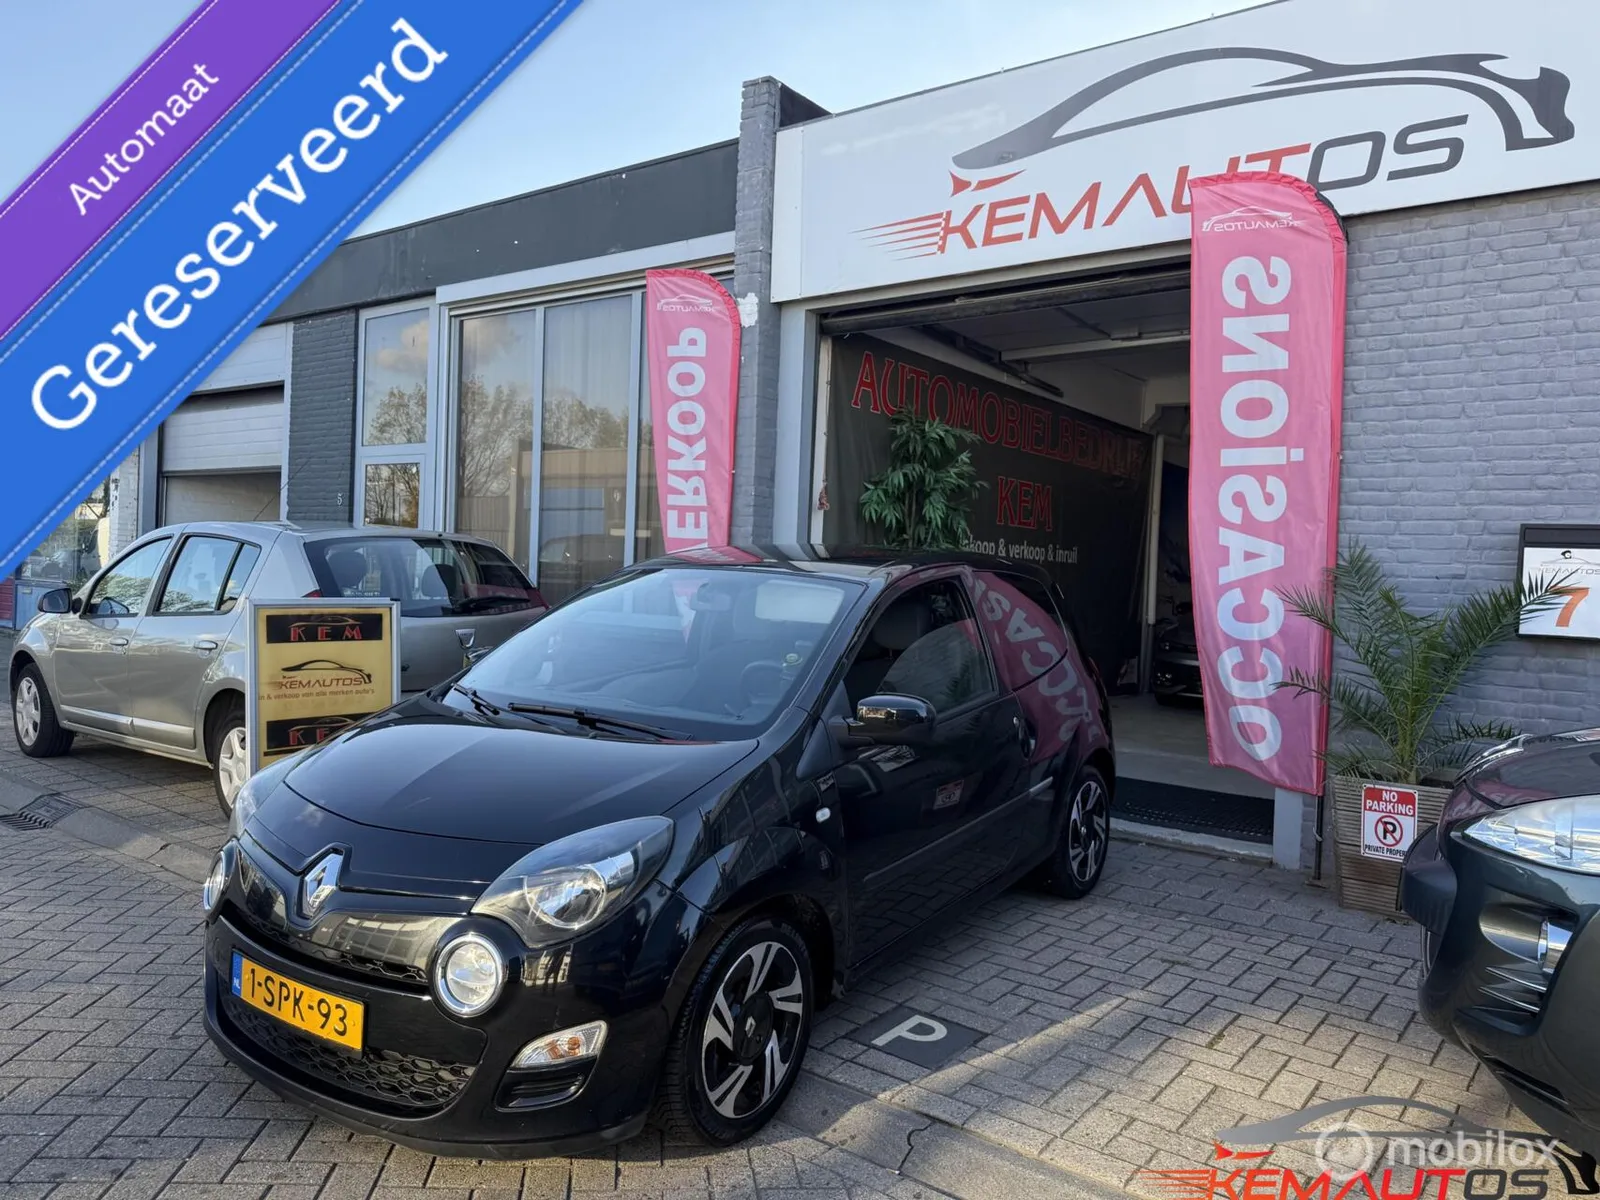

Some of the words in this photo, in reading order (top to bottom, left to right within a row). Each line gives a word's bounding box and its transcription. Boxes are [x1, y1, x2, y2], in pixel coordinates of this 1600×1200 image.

[996, 475, 1054, 532] KEM
[998, 538, 1006, 557] &
[1008, 540, 1046, 565] verkoop
[1047, 543, 1055, 562] &
[1055, 545, 1079, 564] inruil
[1549, 585, 1590, 627] 7
[290, 626, 362, 641] KEM
[279, 677, 362, 689] KEMAUTOS
[273, 692, 299, 700] verkoop
[1382, 791, 1397, 802] NO
[1366, 800, 1413, 815] PARKING
[1365, 844, 1384, 854] PRIVATE
[1386, 848, 1407, 857] PROPER
[250, 967, 349, 1037] 1-SPK-93
[871, 1014, 948, 1047] P
